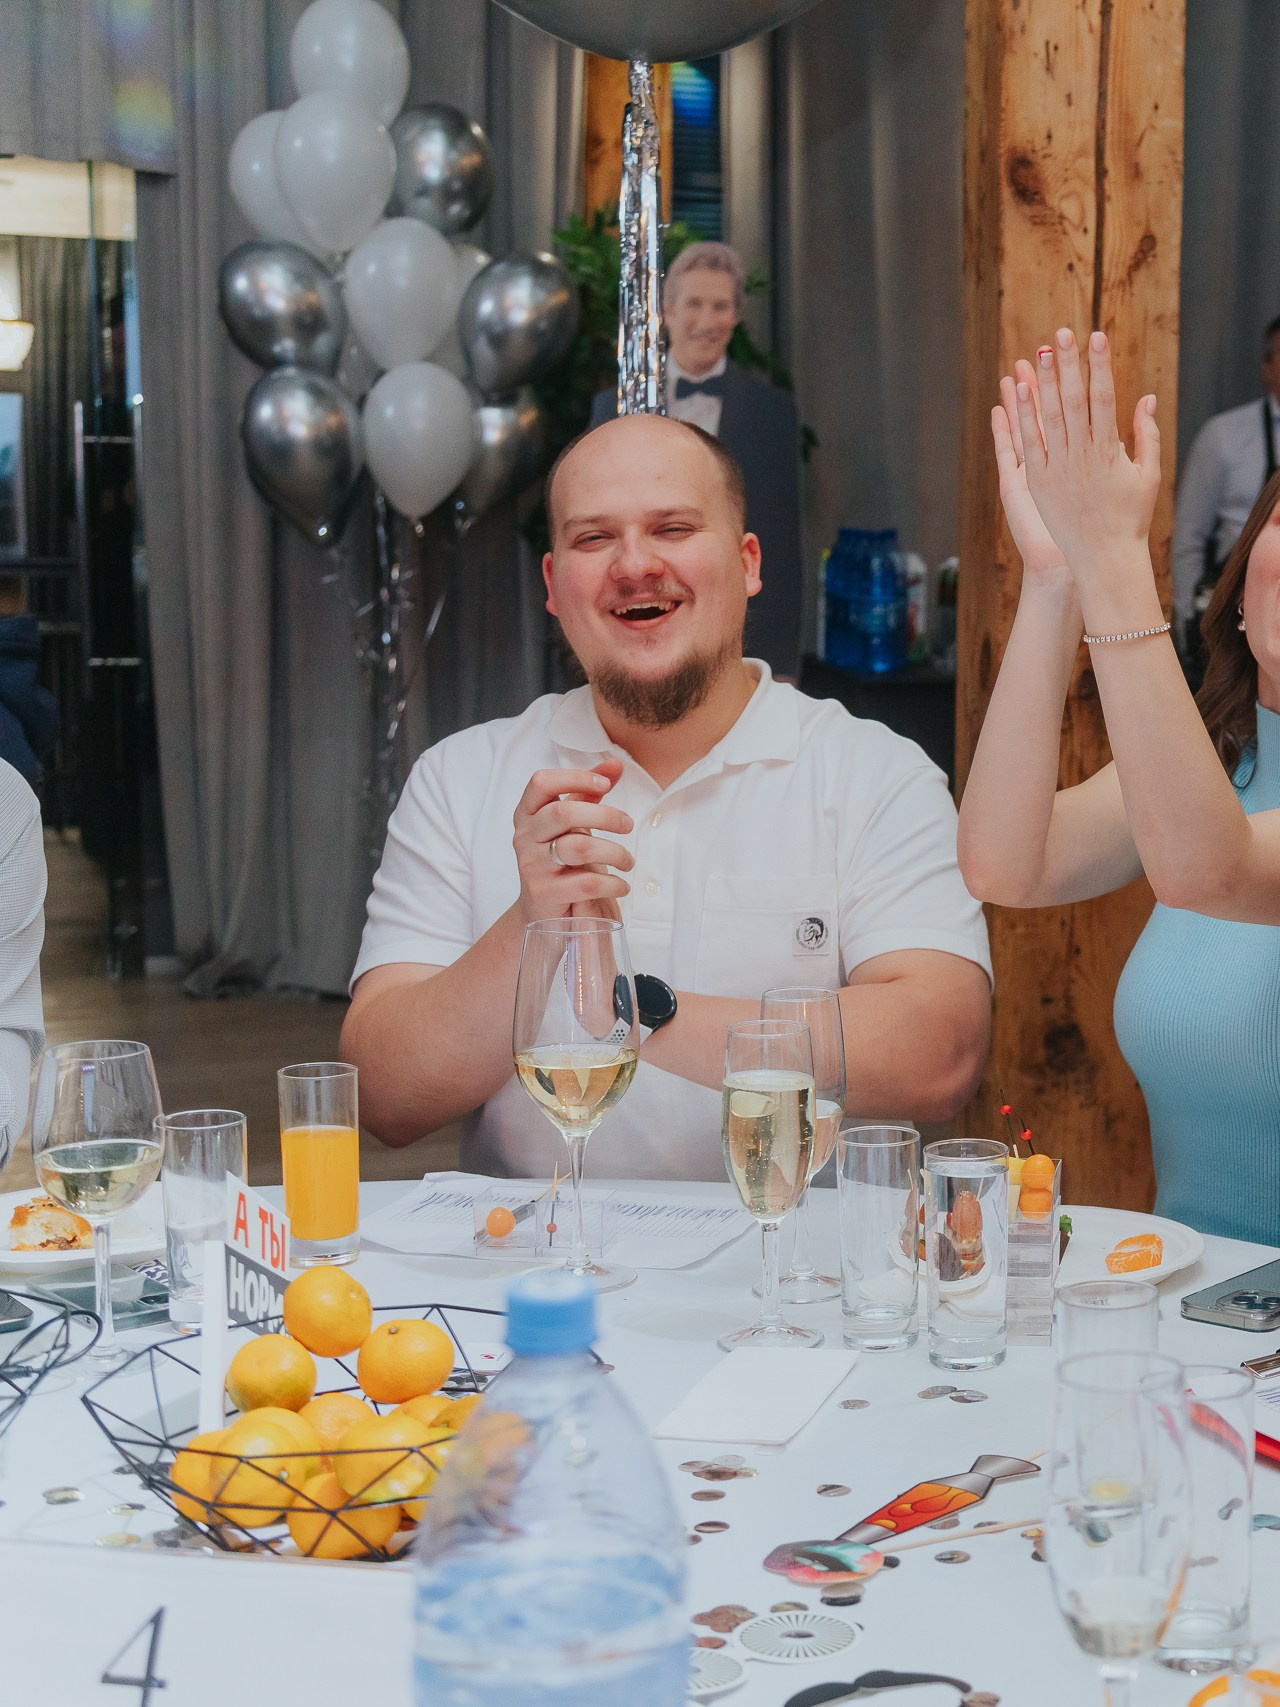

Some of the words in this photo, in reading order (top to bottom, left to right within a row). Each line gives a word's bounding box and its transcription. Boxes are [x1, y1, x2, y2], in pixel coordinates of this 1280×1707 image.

[234, 1191, 249, 1248] А
[259, 1206, 286, 1272] ТЫ
[229, 1255, 292, 1338] НОРМ
[101, 1605, 166, 1707] 4
